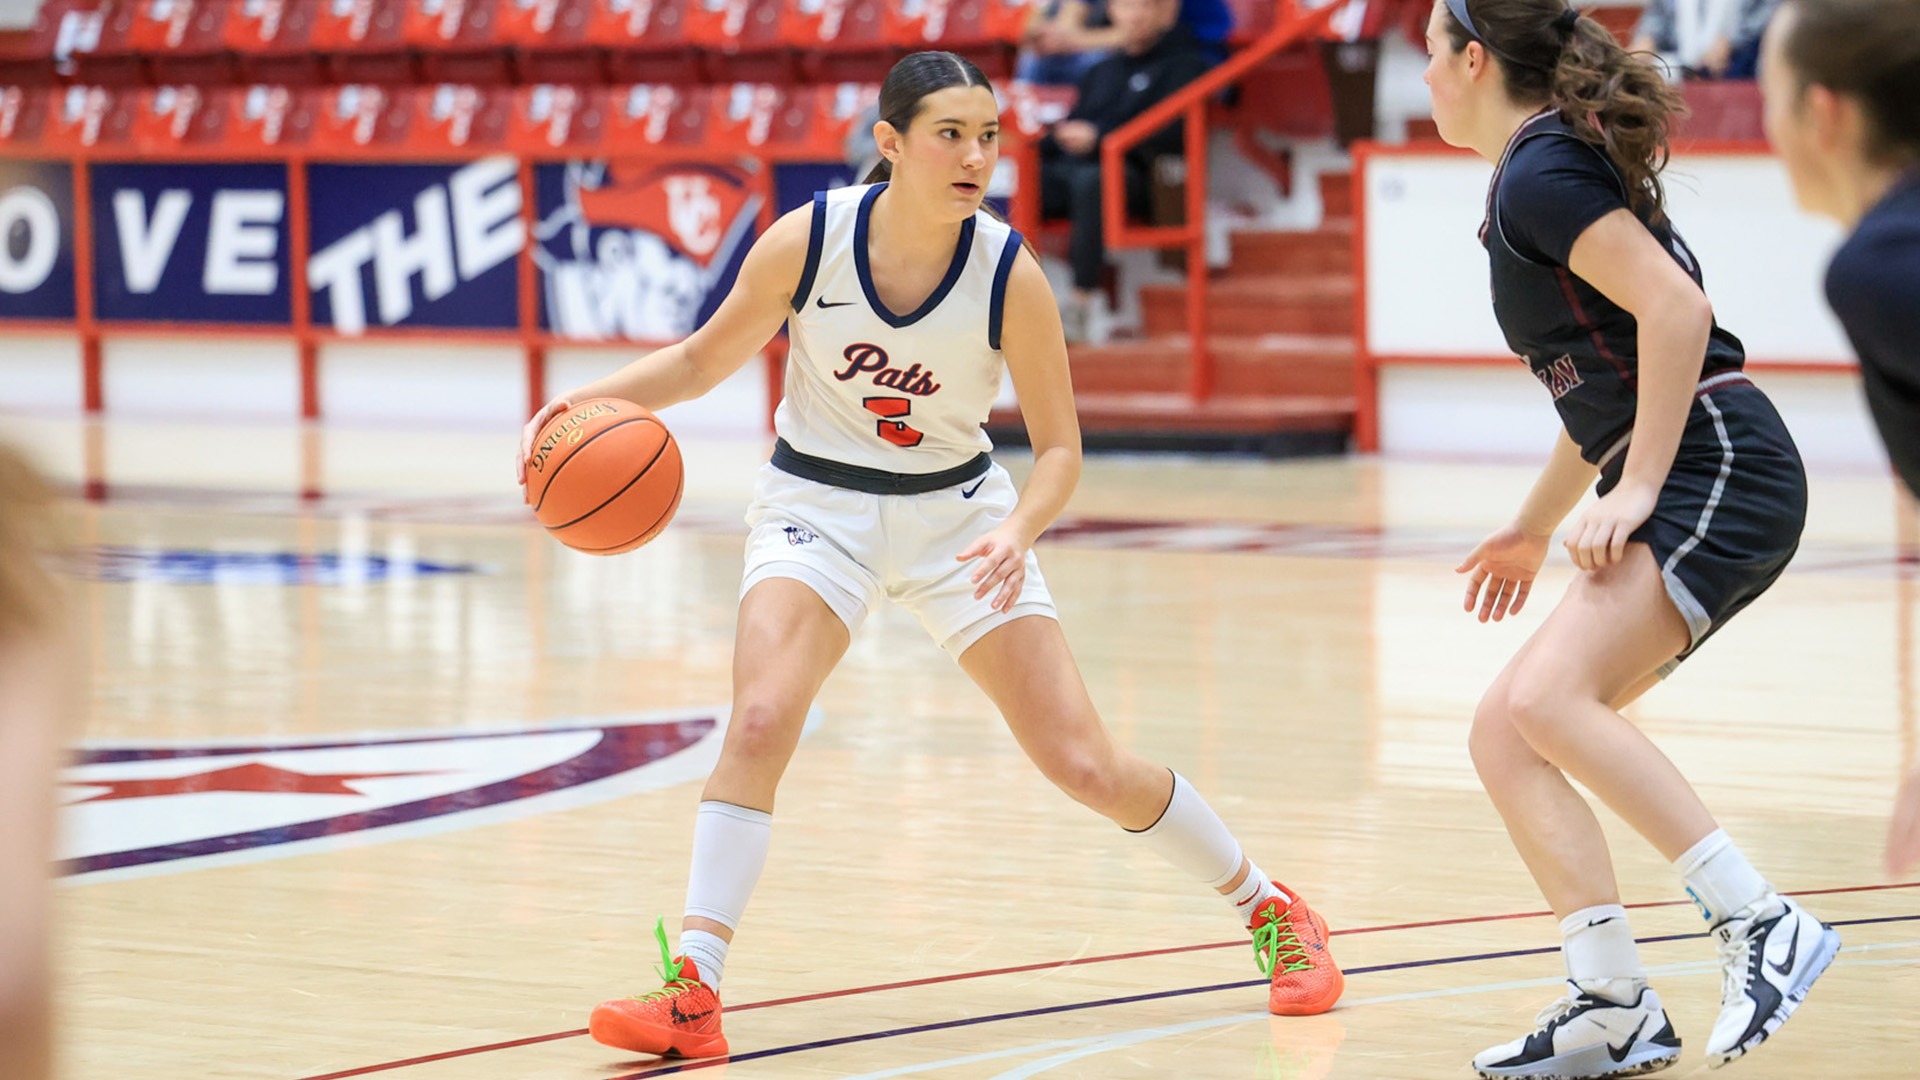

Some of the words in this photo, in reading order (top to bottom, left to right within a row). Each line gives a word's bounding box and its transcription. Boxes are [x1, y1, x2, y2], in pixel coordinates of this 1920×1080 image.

[306, 153, 528, 337] THE
[833, 342, 942, 397] Pats
[531, 401, 619, 474] SPALDING
[862, 396, 925, 448] 5
